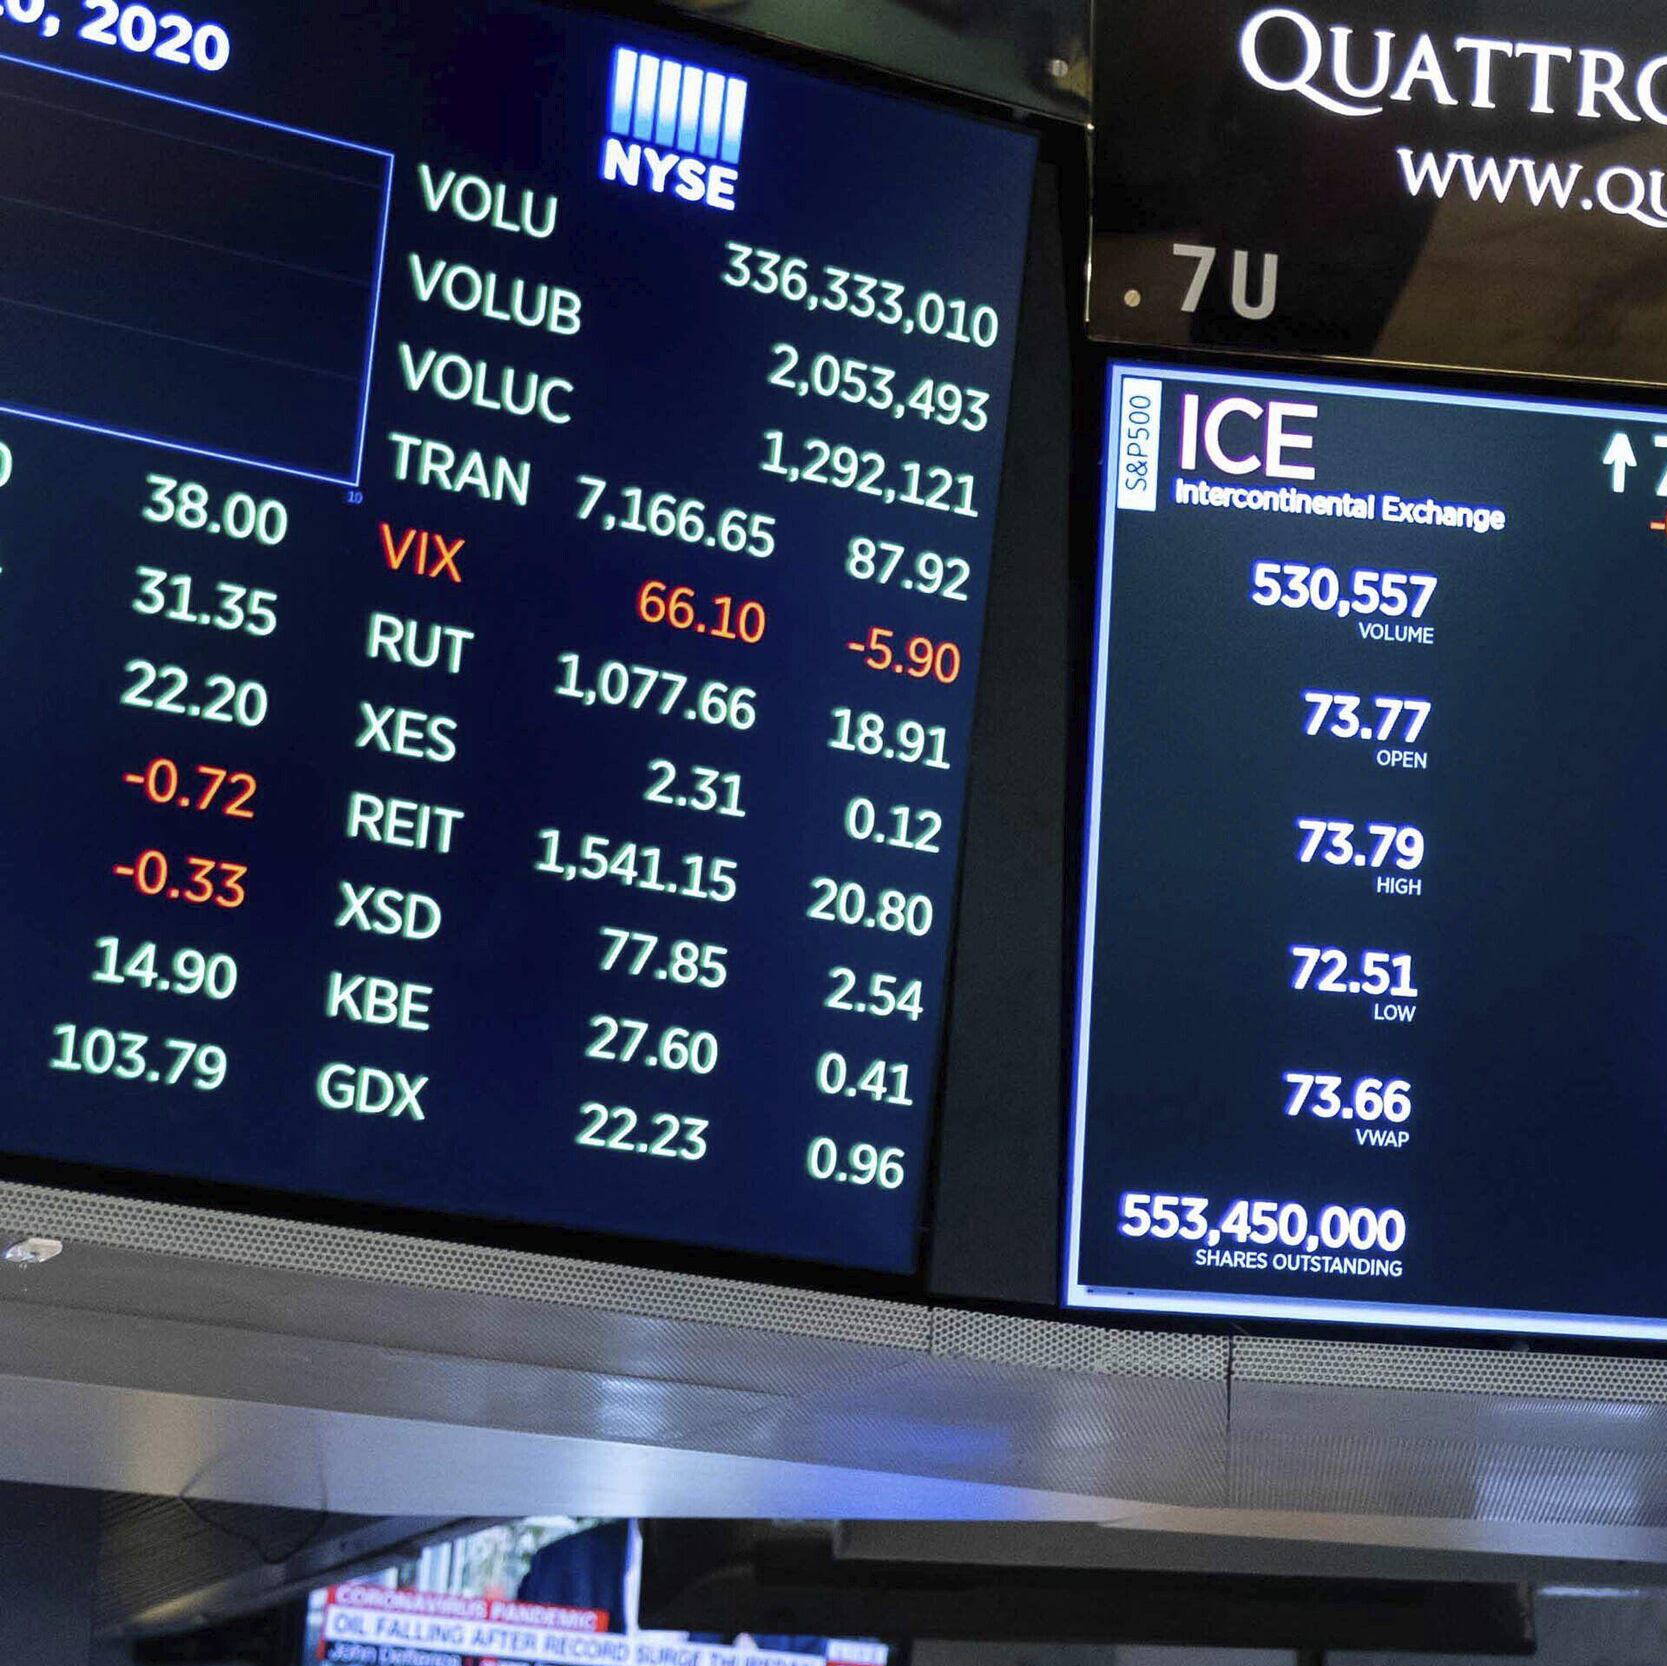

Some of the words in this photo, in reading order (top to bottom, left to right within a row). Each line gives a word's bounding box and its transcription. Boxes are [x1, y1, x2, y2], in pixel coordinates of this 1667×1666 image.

[79, 0, 230, 71] 2020
[419, 163, 558, 239] VOLU
[602, 138, 739, 211] NYSE
[409, 253, 582, 335] VOLUB
[723, 242, 999, 348] 336,333,010
[1172, 242, 1279, 320] 7U
[399, 343, 574, 424] VOLUC
[768, 343, 990, 432] 2,053,493
[761, 430, 979, 518] 1,292,121
[1122, 394, 1151, 492] S&P500
[1181, 393, 1319, 481] ICE
[142, 474, 288, 545] 38.00
[389, 432, 531, 506] TRAN
[578, 475, 776, 558] 7,166.65
[846, 537, 971, 602] 87.92
[1175, 477, 1376, 520] Intercontinental
[1381, 494, 1506, 534] Exchange
[132, 566, 278, 636] 31.35
[381, 523, 466, 583] VIX
[639, 580, 766, 644] 66.10
[848, 627, 961, 684] -5.90
[1251, 562, 1438, 619] 530,557
[1358, 621, 1435, 645] VOLUME
[121, 659, 268, 727] 22.20
[367, 612, 475, 674] RUT
[555, 653, 757, 731] 1,077.66
[828, 708, 951, 770] 18.91
[1304, 691, 1432, 743] 73.77
[125, 758, 257, 818] -0.72
[356, 702, 458, 763] XES
[644, 759, 746, 818] 2.31
[845, 797, 942, 854] 0.12
[1376, 749, 1428, 769] OPEN
[114, 850, 248, 908] -0.33
[347, 791, 465, 854] REIT
[536, 828, 738, 902] 1,541.15
[806, 877, 933, 937] 20.80
[1297, 819, 1425, 871] 73.79
[1376, 875, 1422, 896] HIGH
[92, 936, 238, 1000] 14.90
[336, 881, 442, 940] XSD
[601, 927, 728, 989] 77.85
[824, 966, 924, 1022] 2.54
[1291, 946, 1418, 998] 72.51
[50, 1023, 227, 1090] 103.79
[327, 971, 433, 1031] KBE
[585, 1015, 718, 1075] 27.60
[817, 1052, 913, 1106] 0.41
[1373, 1003, 1417, 1023] LOW
[317, 1063, 429, 1121] GDX
[576, 1102, 710, 1161] 22.23
[807, 1137, 905, 1189] 0.96
[1285, 1072, 1412, 1123] 73.66
[1355, 1128, 1410, 1148] VWAP
[1121, 1193, 1407, 1253] 553,450,000
[1195, 1248, 1268, 1270] SHARES
[1272, 1253, 1403, 1277] OUTSTANDING
[375, 1615, 466, 1644] FALLING
[473, 1624, 537, 1649] AFTER
[545, 1631, 629, 1661] RECORD
